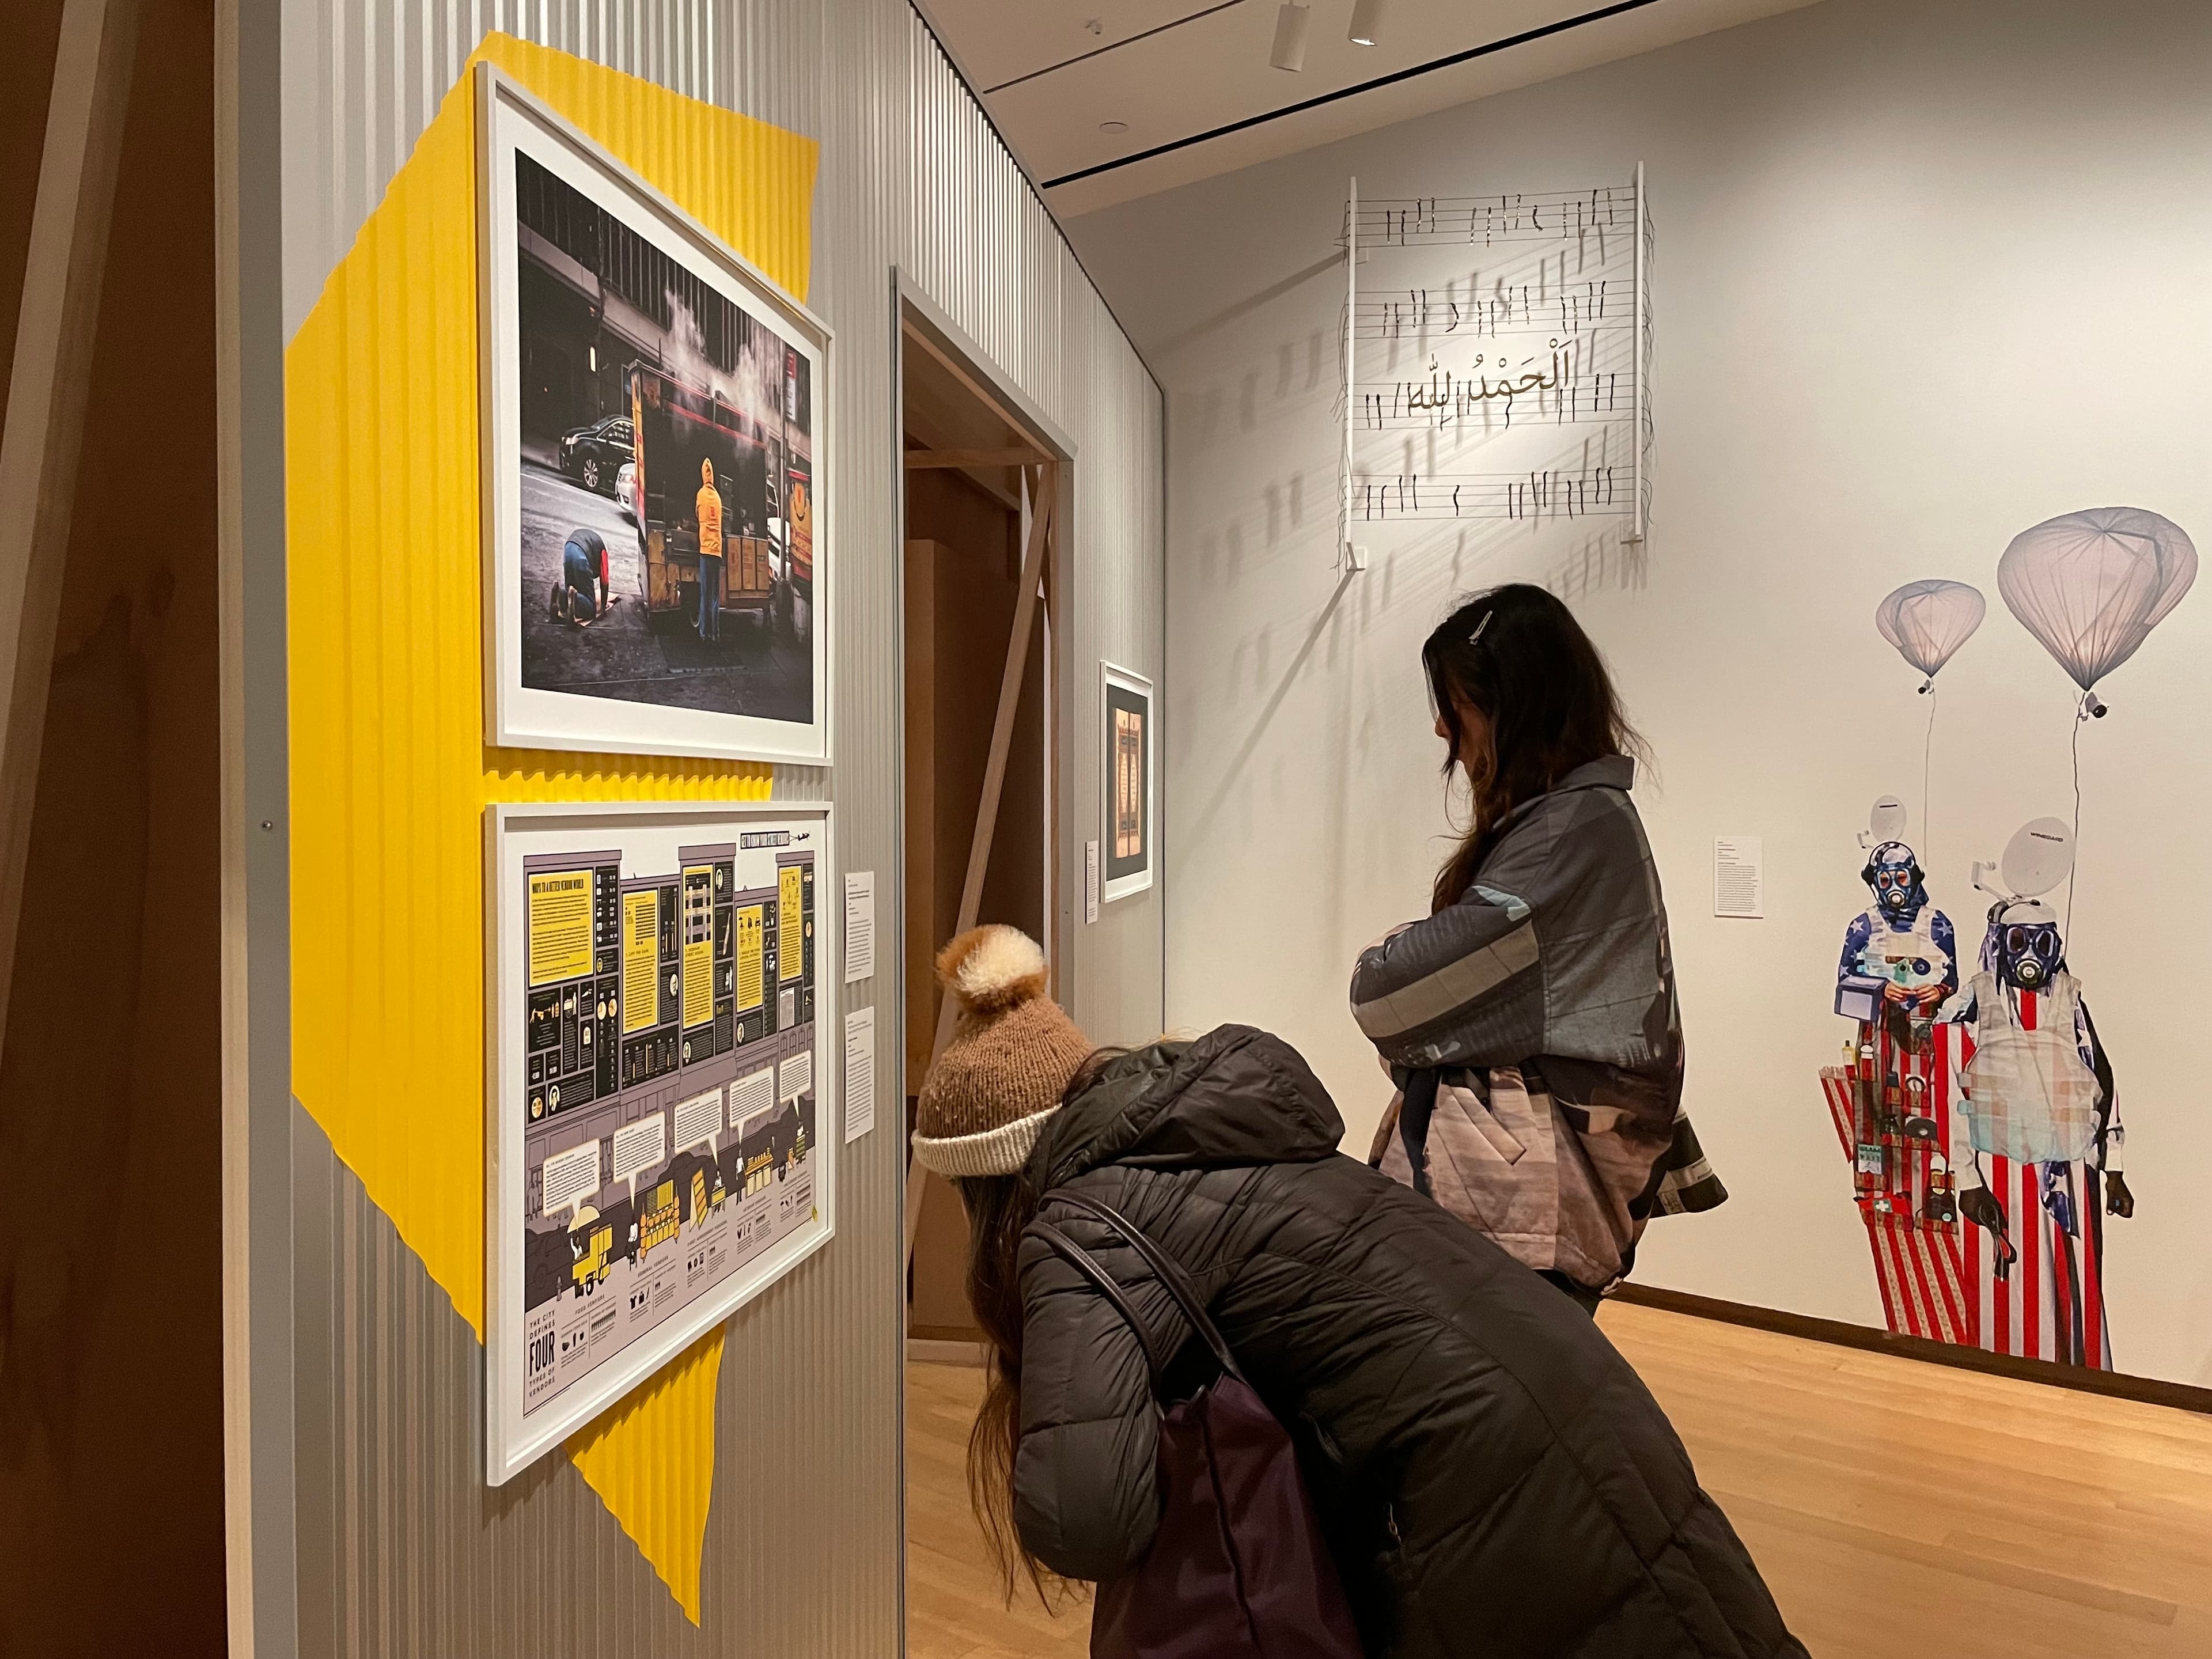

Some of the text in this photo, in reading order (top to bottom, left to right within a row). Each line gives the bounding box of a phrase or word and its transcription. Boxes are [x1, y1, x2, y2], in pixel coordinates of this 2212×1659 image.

[530, 1309, 555, 1328] THE CITY
[529, 1319, 555, 1340] DEFINES
[529, 1331, 555, 1377] FOUR
[529, 1367, 555, 1387] TYPES OF
[529, 1376, 555, 1397] VENDORS
